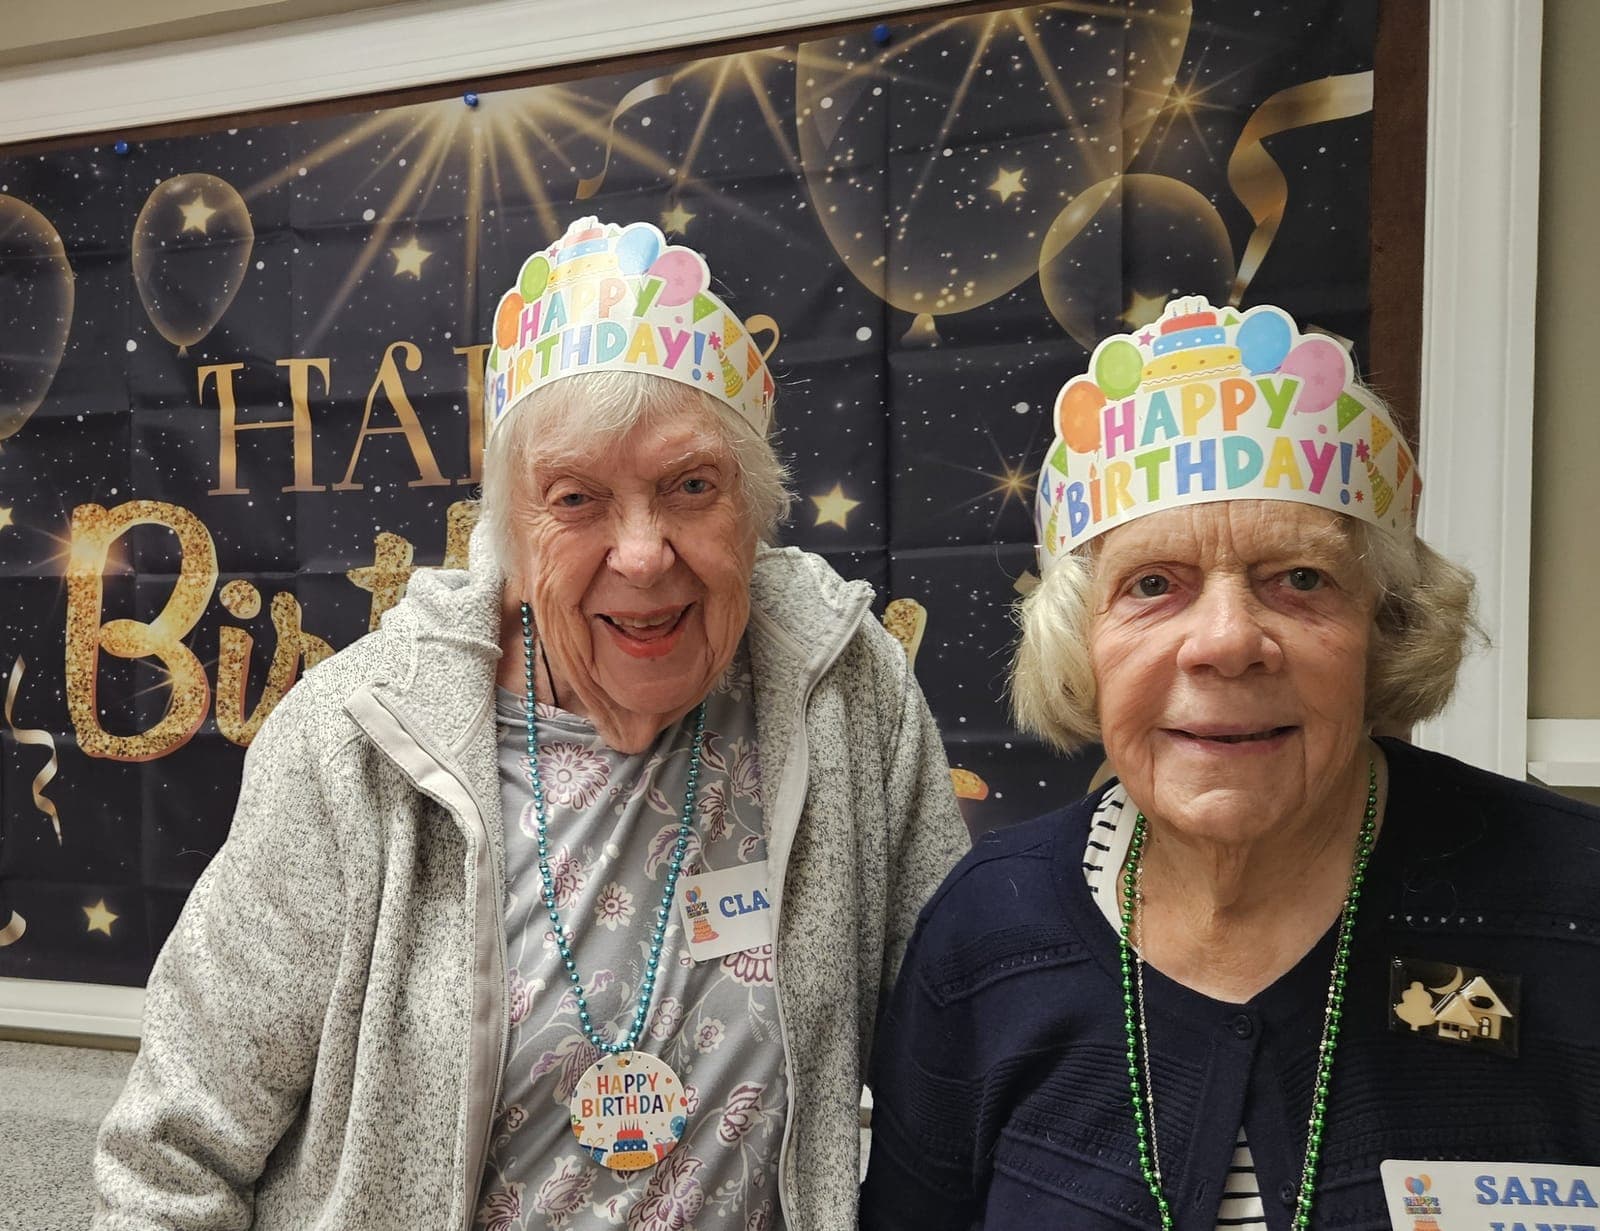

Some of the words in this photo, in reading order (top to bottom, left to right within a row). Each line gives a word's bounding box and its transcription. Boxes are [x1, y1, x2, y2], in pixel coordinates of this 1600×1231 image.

[520, 277, 662, 350] HAPPY
[495, 322, 706, 419] BIRTHDAY!
[1104, 378, 1299, 459] HAPPY
[1066, 436, 1352, 537] BIRTHDAY!
[719, 888, 770, 918] CLA
[581, 1092, 675, 1118] BIRTHDAY
[597, 1072, 658, 1095] HAPPY
[1474, 1175, 1598, 1208] SARA
